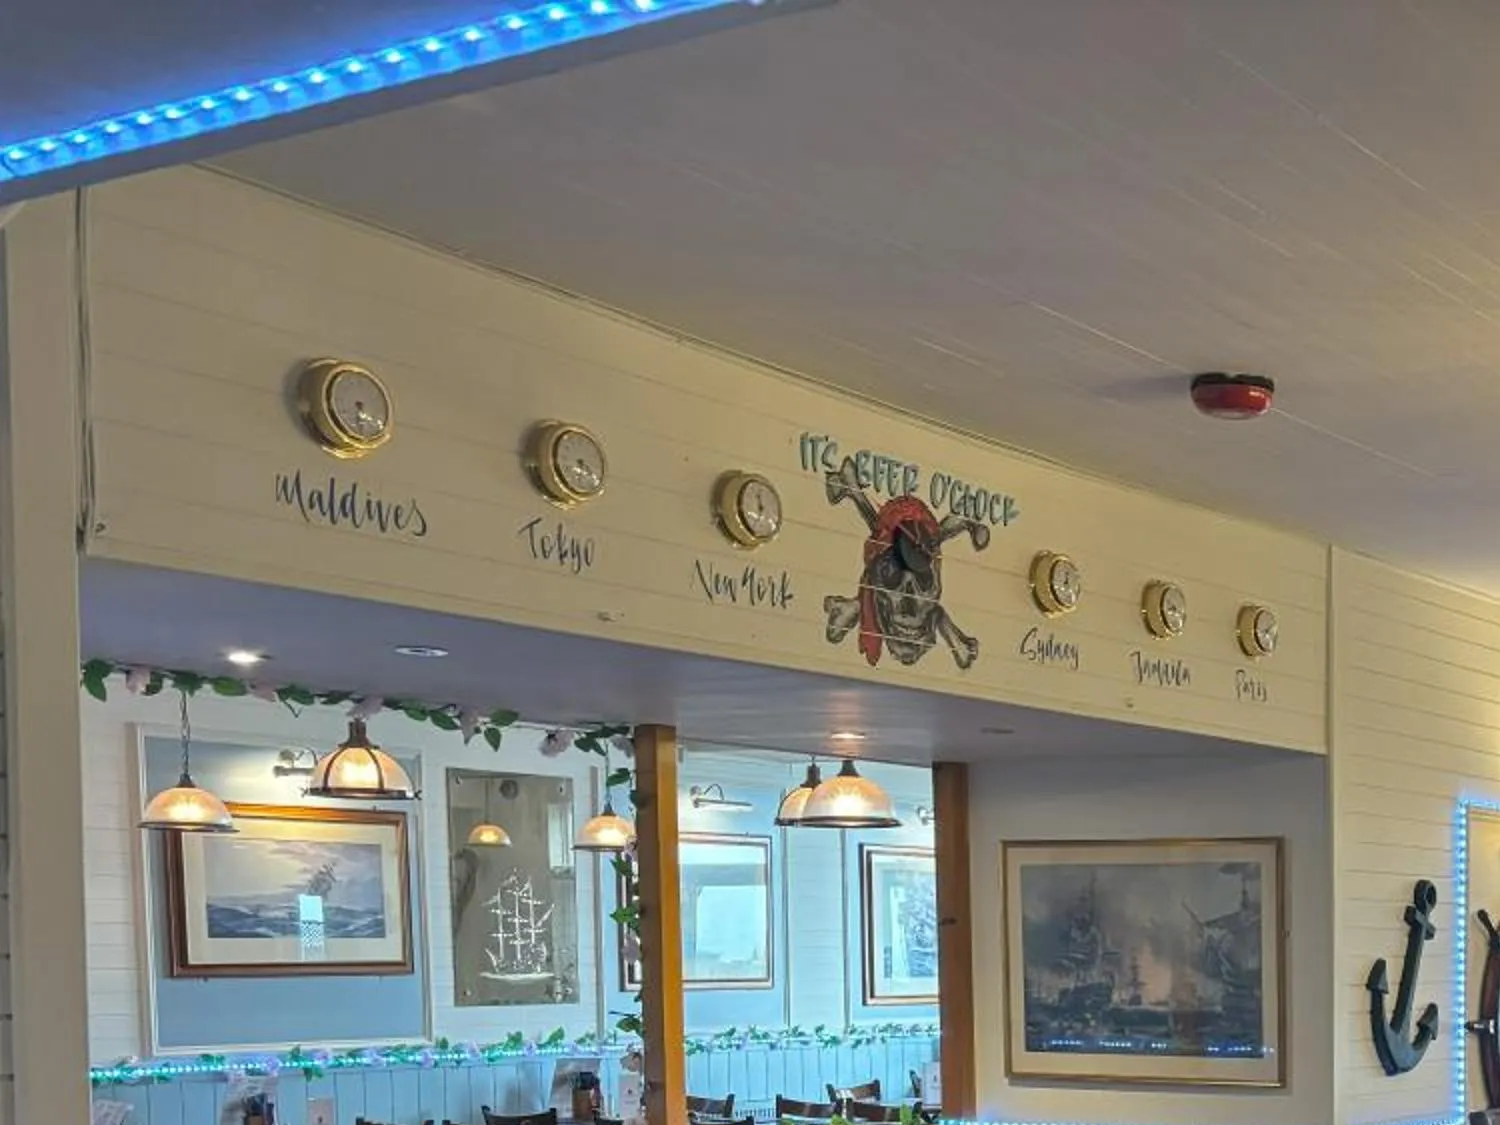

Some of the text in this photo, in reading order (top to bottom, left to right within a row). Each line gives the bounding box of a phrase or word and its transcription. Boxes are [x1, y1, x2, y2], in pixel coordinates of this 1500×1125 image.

[274, 469, 428, 537] Maldives
[799, 431, 1021, 528] IT'S BEER O'CLOCK
[517, 516, 596, 575] Tokyo
[690, 559, 794, 610] New York
[1019, 626, 1079, 671] Sydney
[1129, 650, 1191, 688] Jamaica
[1235, 668, 1268, 702] Paris
